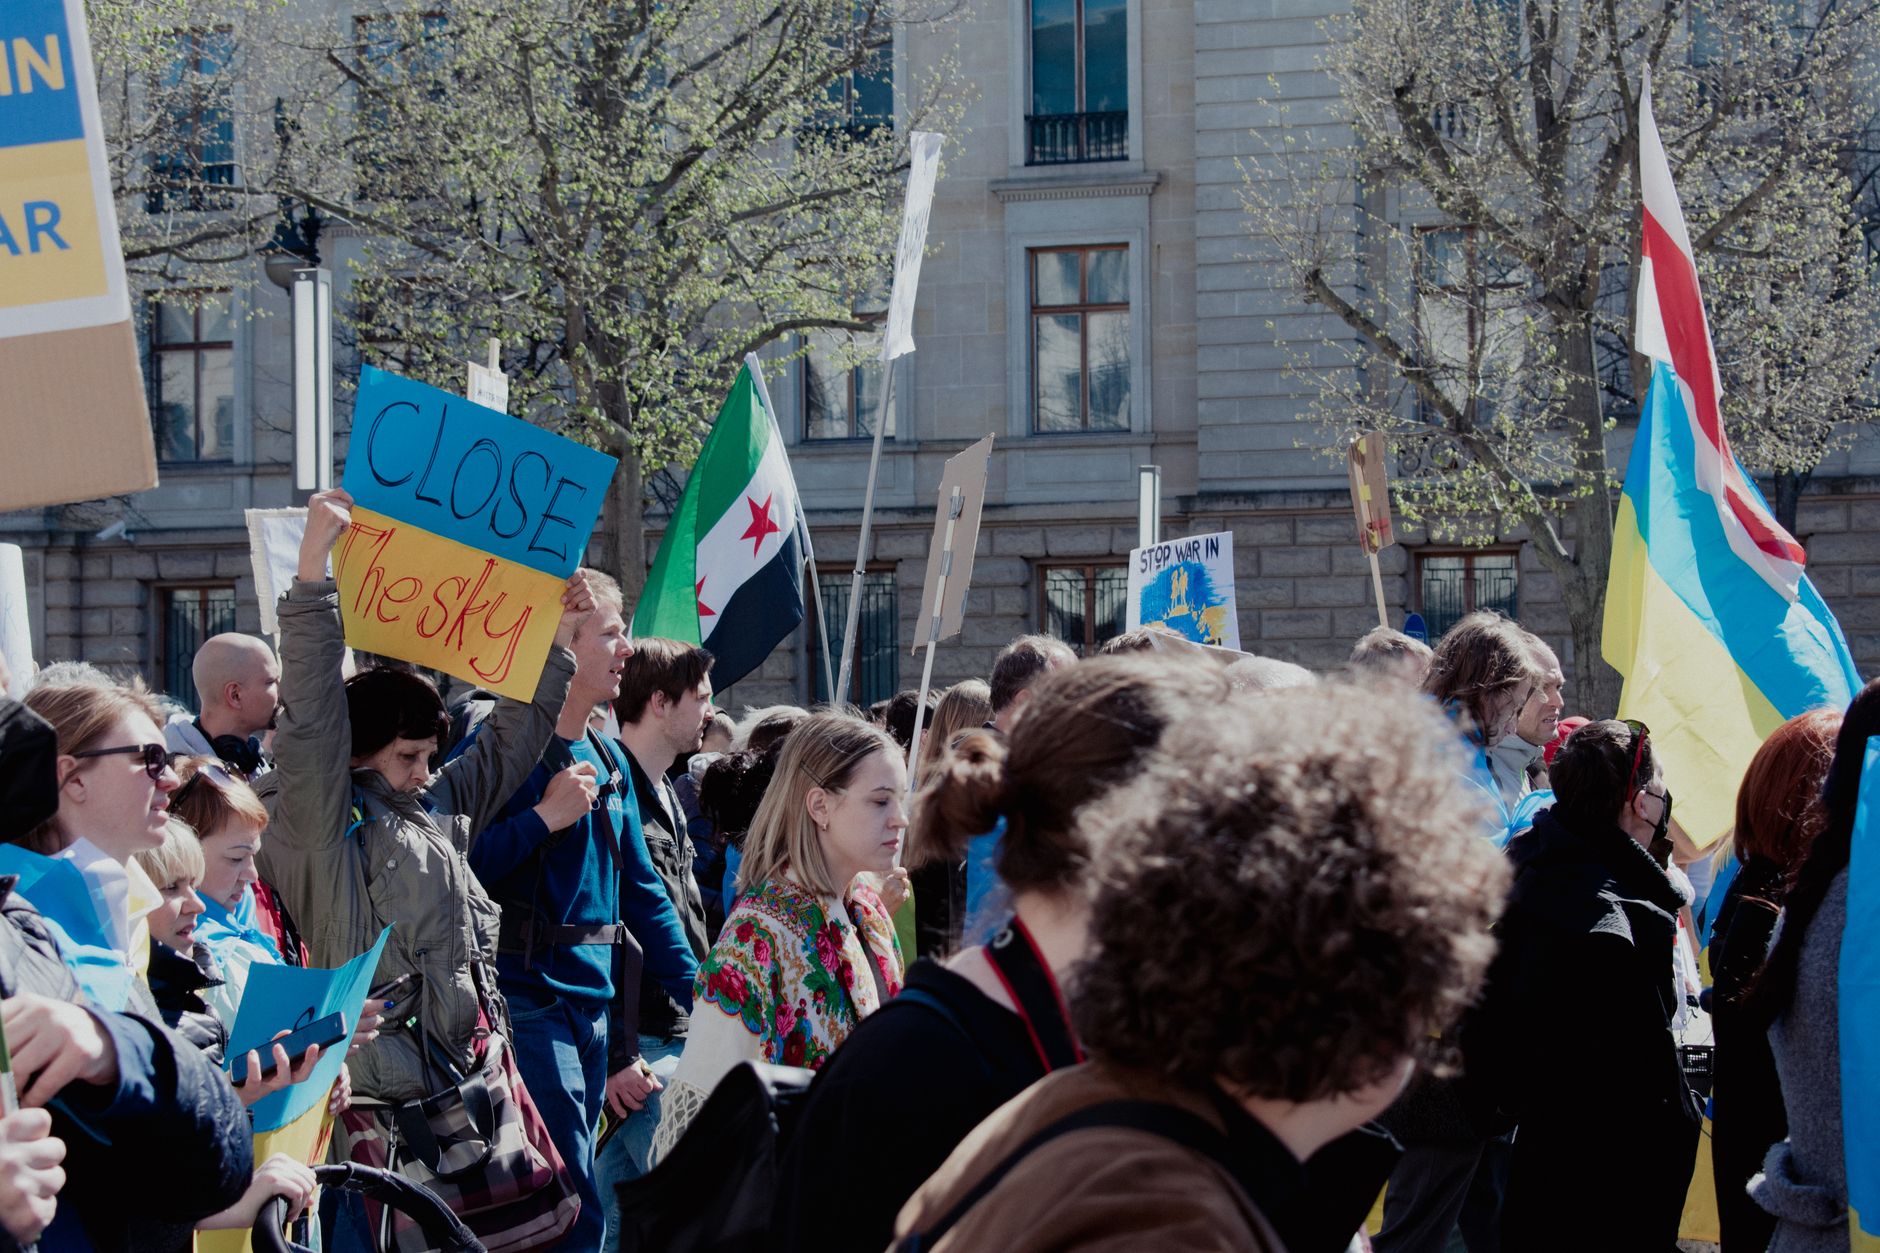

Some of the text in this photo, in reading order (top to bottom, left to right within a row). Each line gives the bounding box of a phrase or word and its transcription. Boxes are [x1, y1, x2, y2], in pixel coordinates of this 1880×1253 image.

[367, 400, 587, 563] CLOSE
[1140, 536, 1220, 574] STOP WAR IN
